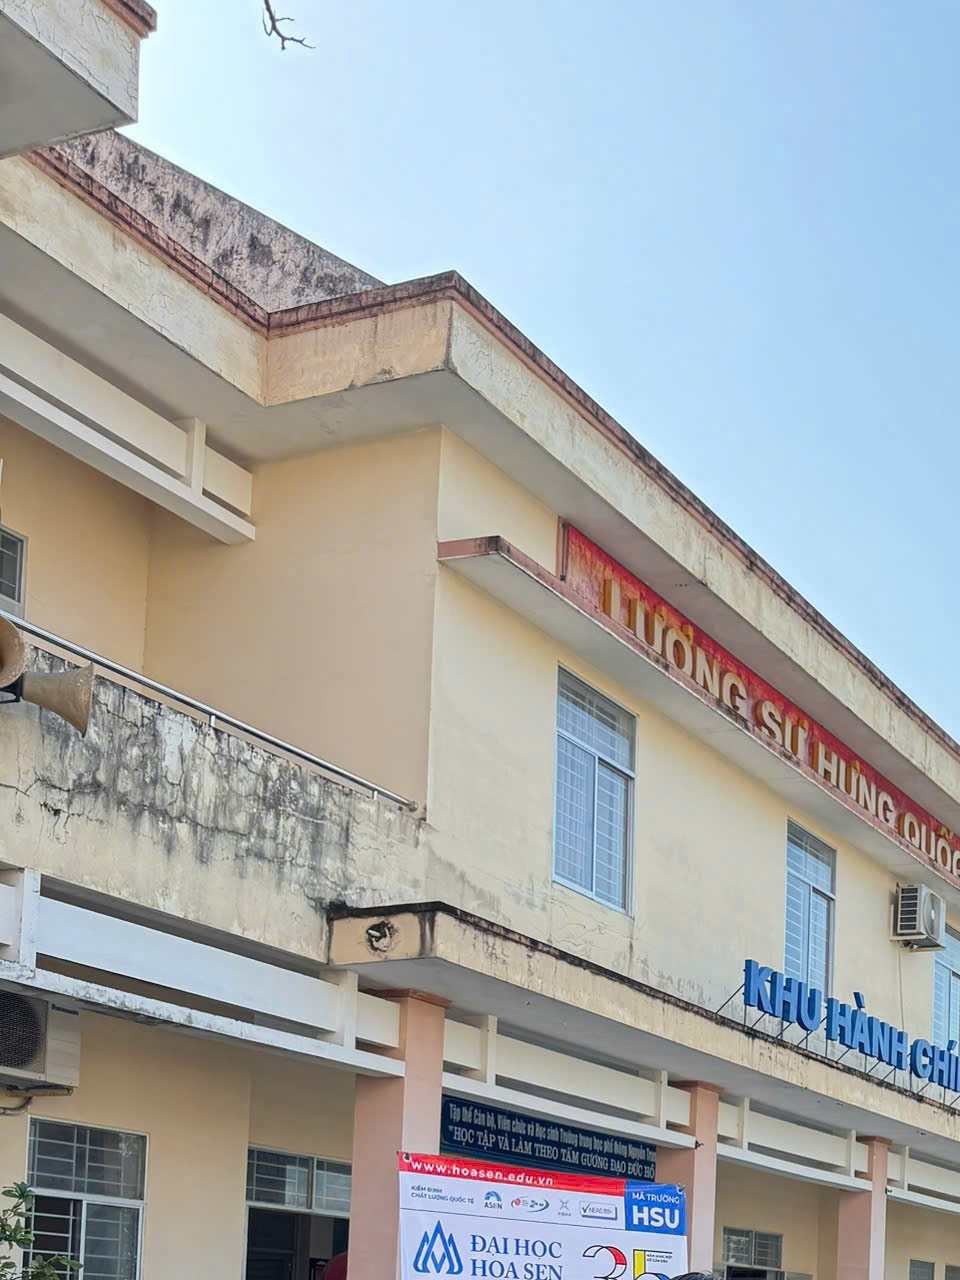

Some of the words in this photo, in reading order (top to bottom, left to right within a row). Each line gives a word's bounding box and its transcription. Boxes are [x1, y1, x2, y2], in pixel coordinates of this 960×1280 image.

[758, 699, 809, 761] SƯ
[814, 742, 898, 829] HƯNG
[744, 959, 822, 1032] KHU
[826, 991, 909, 1071] HÀNH
[476, 1130, 496, 1151] TẬP
[498, 1132, 510, 1150] VÀ
[512, 1137, 532, 1155] LÀM
[534, 1143, 559, 1160] THEO
[581, 1152, 609, 1170] GƯƠNG
[610, 1158, 626, 1176] ĐẠO
[628, 1160, 643, 1177] ĐỨC
[410, 1160, 554, 1186] www.hoasen.edu.vn
[632, 1204, 680, 1229] HSU
[471, 1234, 513, 1257] ĐẠI
[515, 1238, 562, 1260] HỌC
[471, 1260, 522, 1280] HOA
